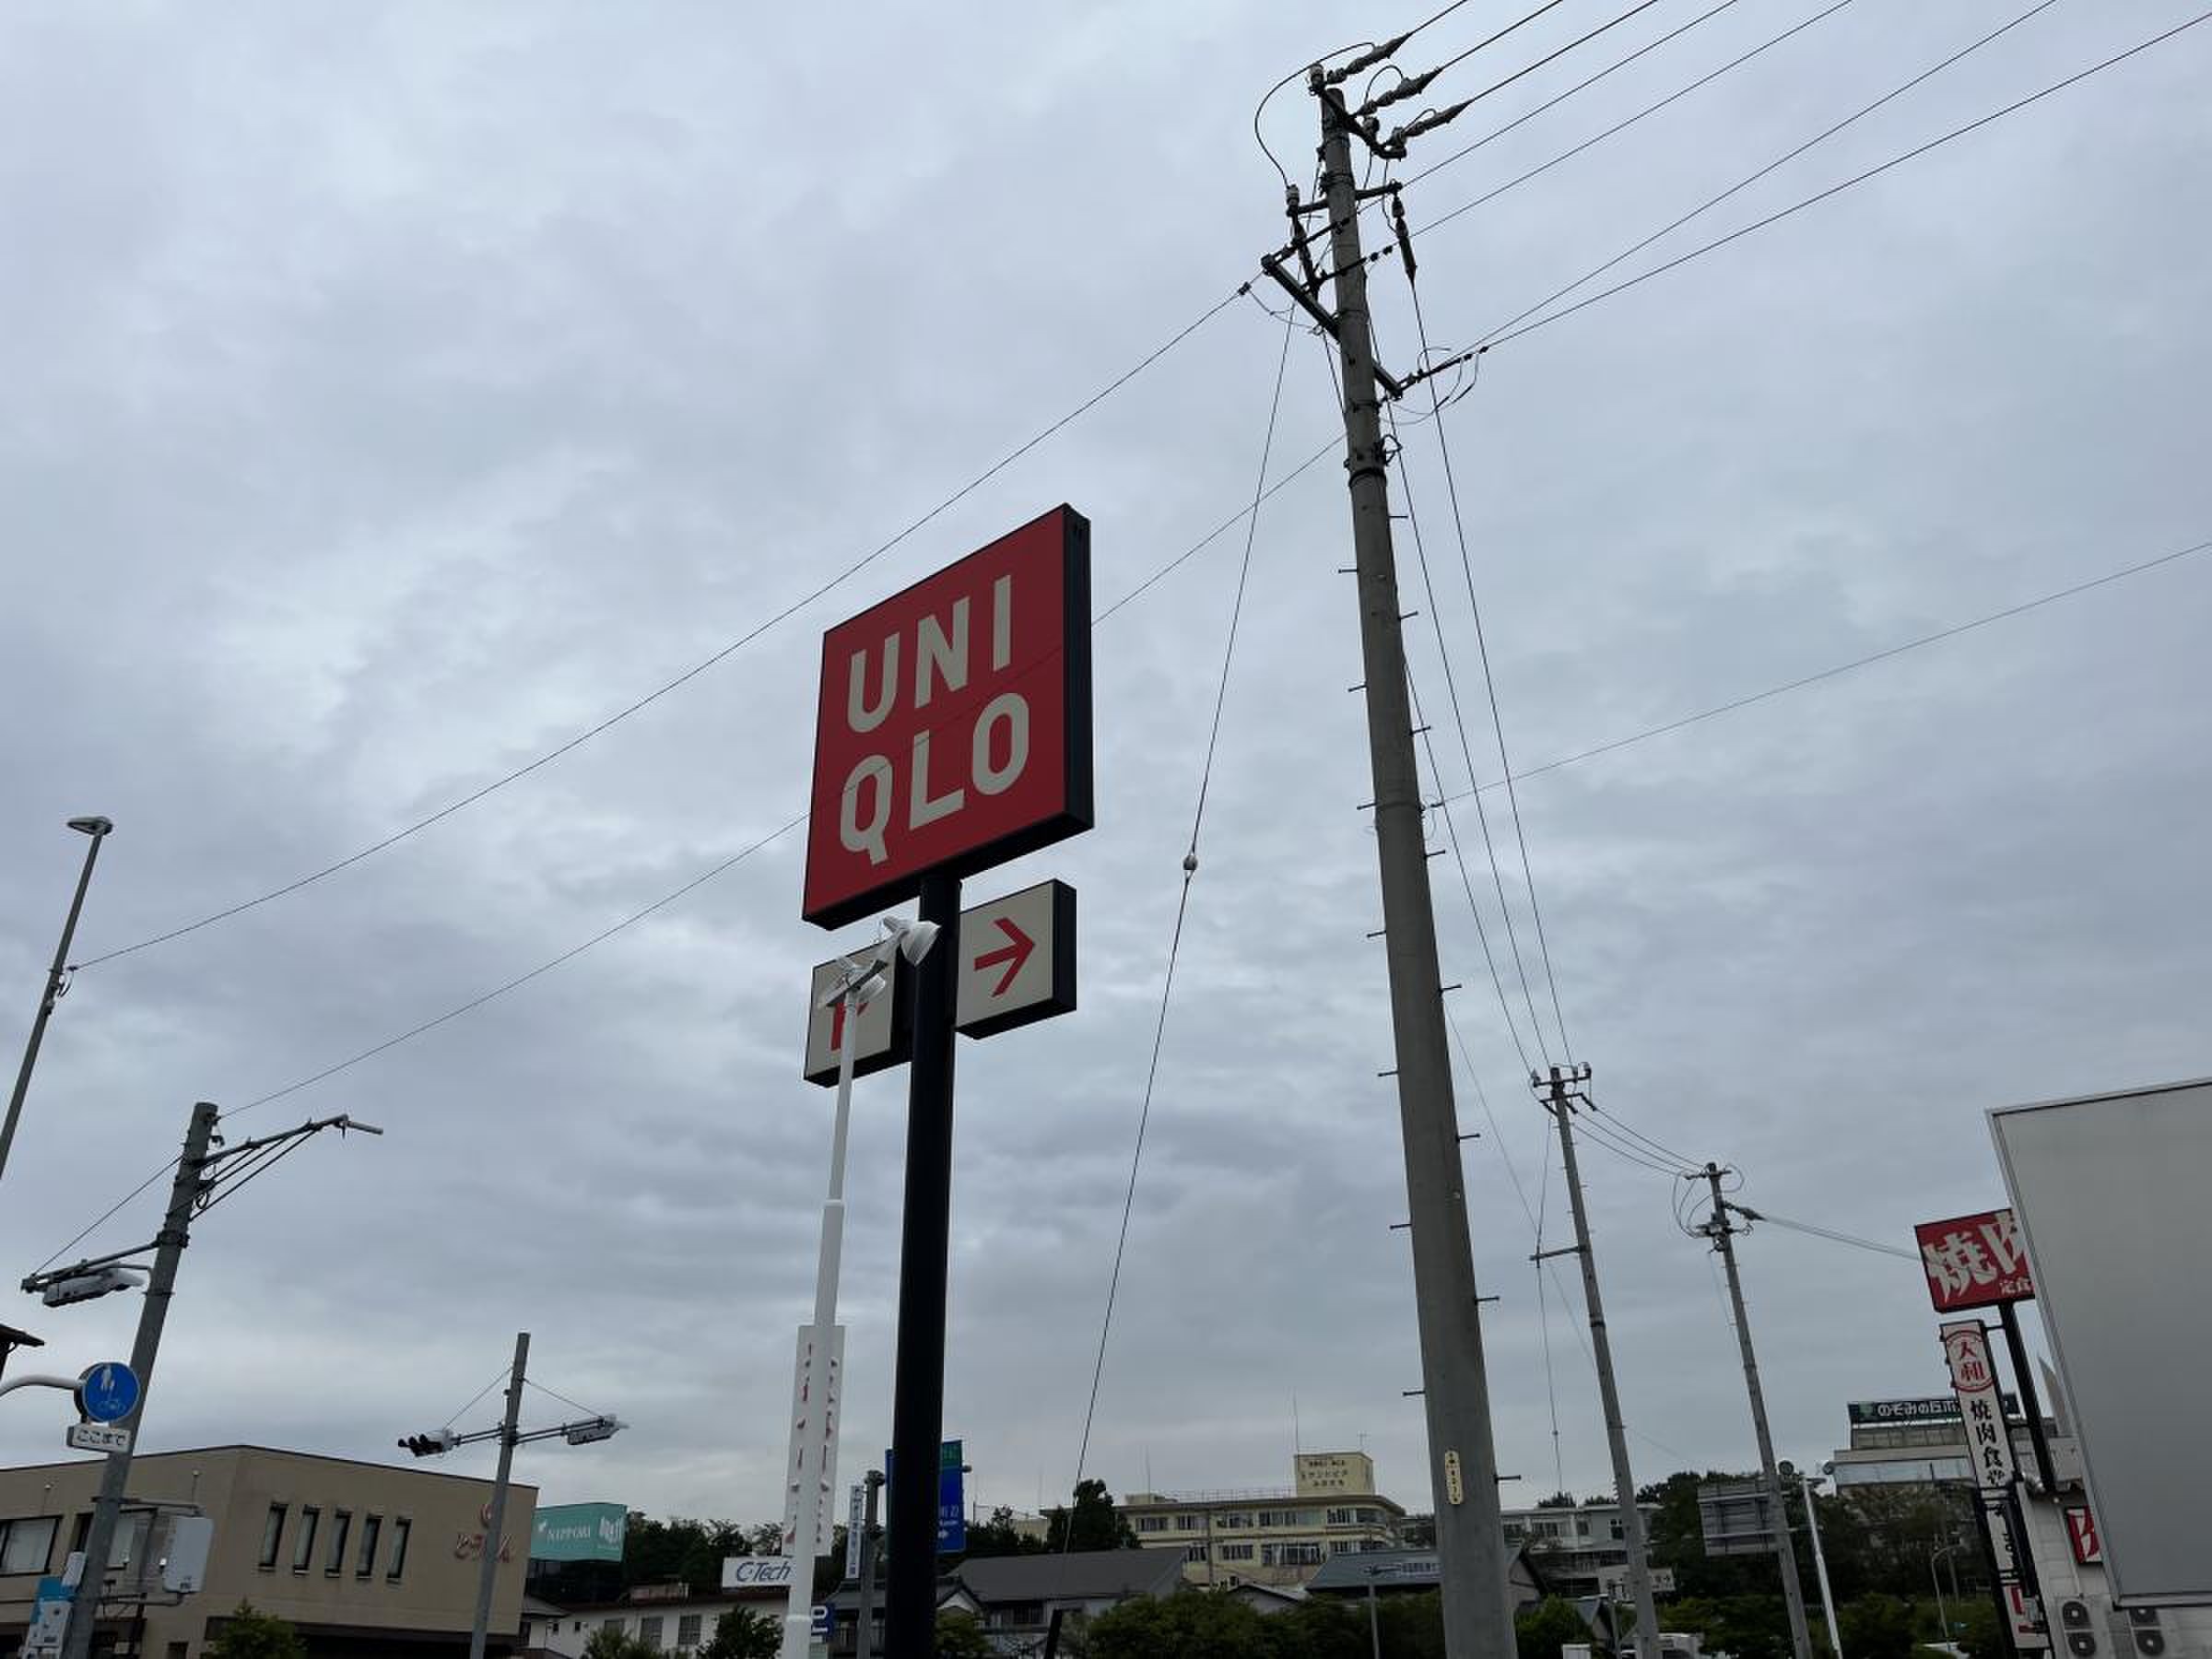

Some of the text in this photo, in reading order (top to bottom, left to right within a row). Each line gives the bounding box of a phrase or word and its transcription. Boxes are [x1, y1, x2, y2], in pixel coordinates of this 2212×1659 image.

[846, 575, 1012, 734] UNI
[840, 692, 1030, 866] QLO
[76, 1429, 127, 1446] ここまで
[1970, 1399, 2006, 1486] 焼肉食堂
